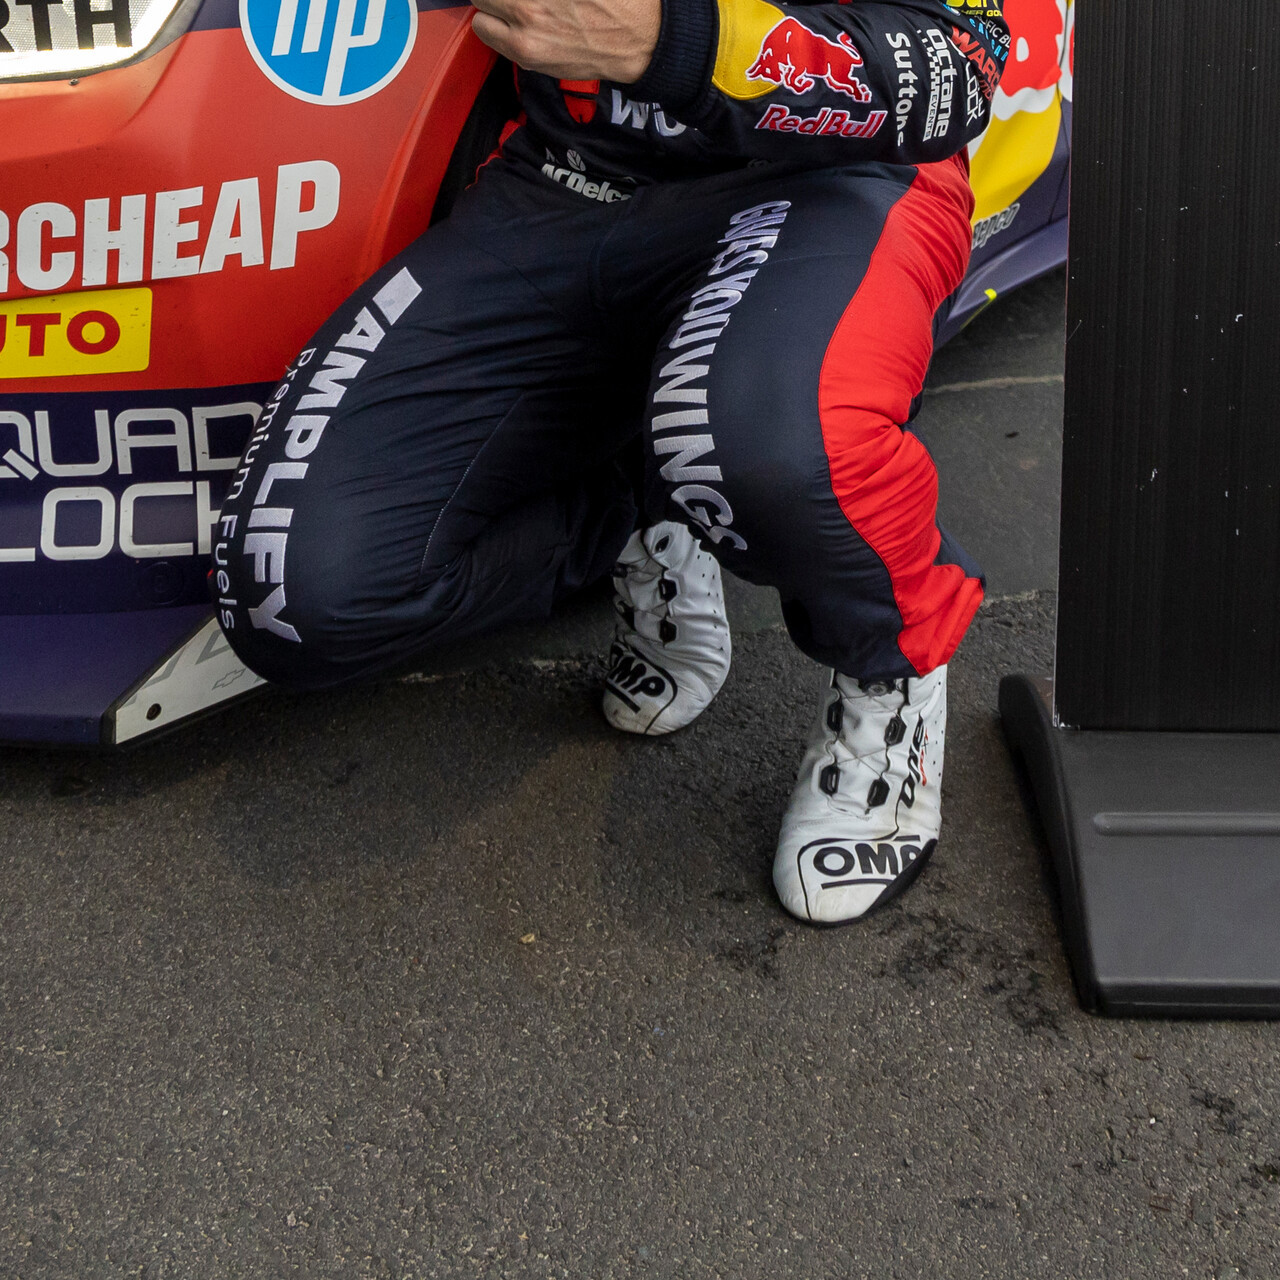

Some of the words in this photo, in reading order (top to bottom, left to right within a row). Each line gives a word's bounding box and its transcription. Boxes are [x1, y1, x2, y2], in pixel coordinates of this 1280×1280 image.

[755, 103, 819, 134] Red
[818, 107, 888, 139] Bull
[926, 28, 958, 138] octane
[227, 346, 317, 500] Premium
[243, 306, 386, 643] AMPLIFY
[214, 513, 238, 631] Fuels
[813, 842, 922, 877] OMP
